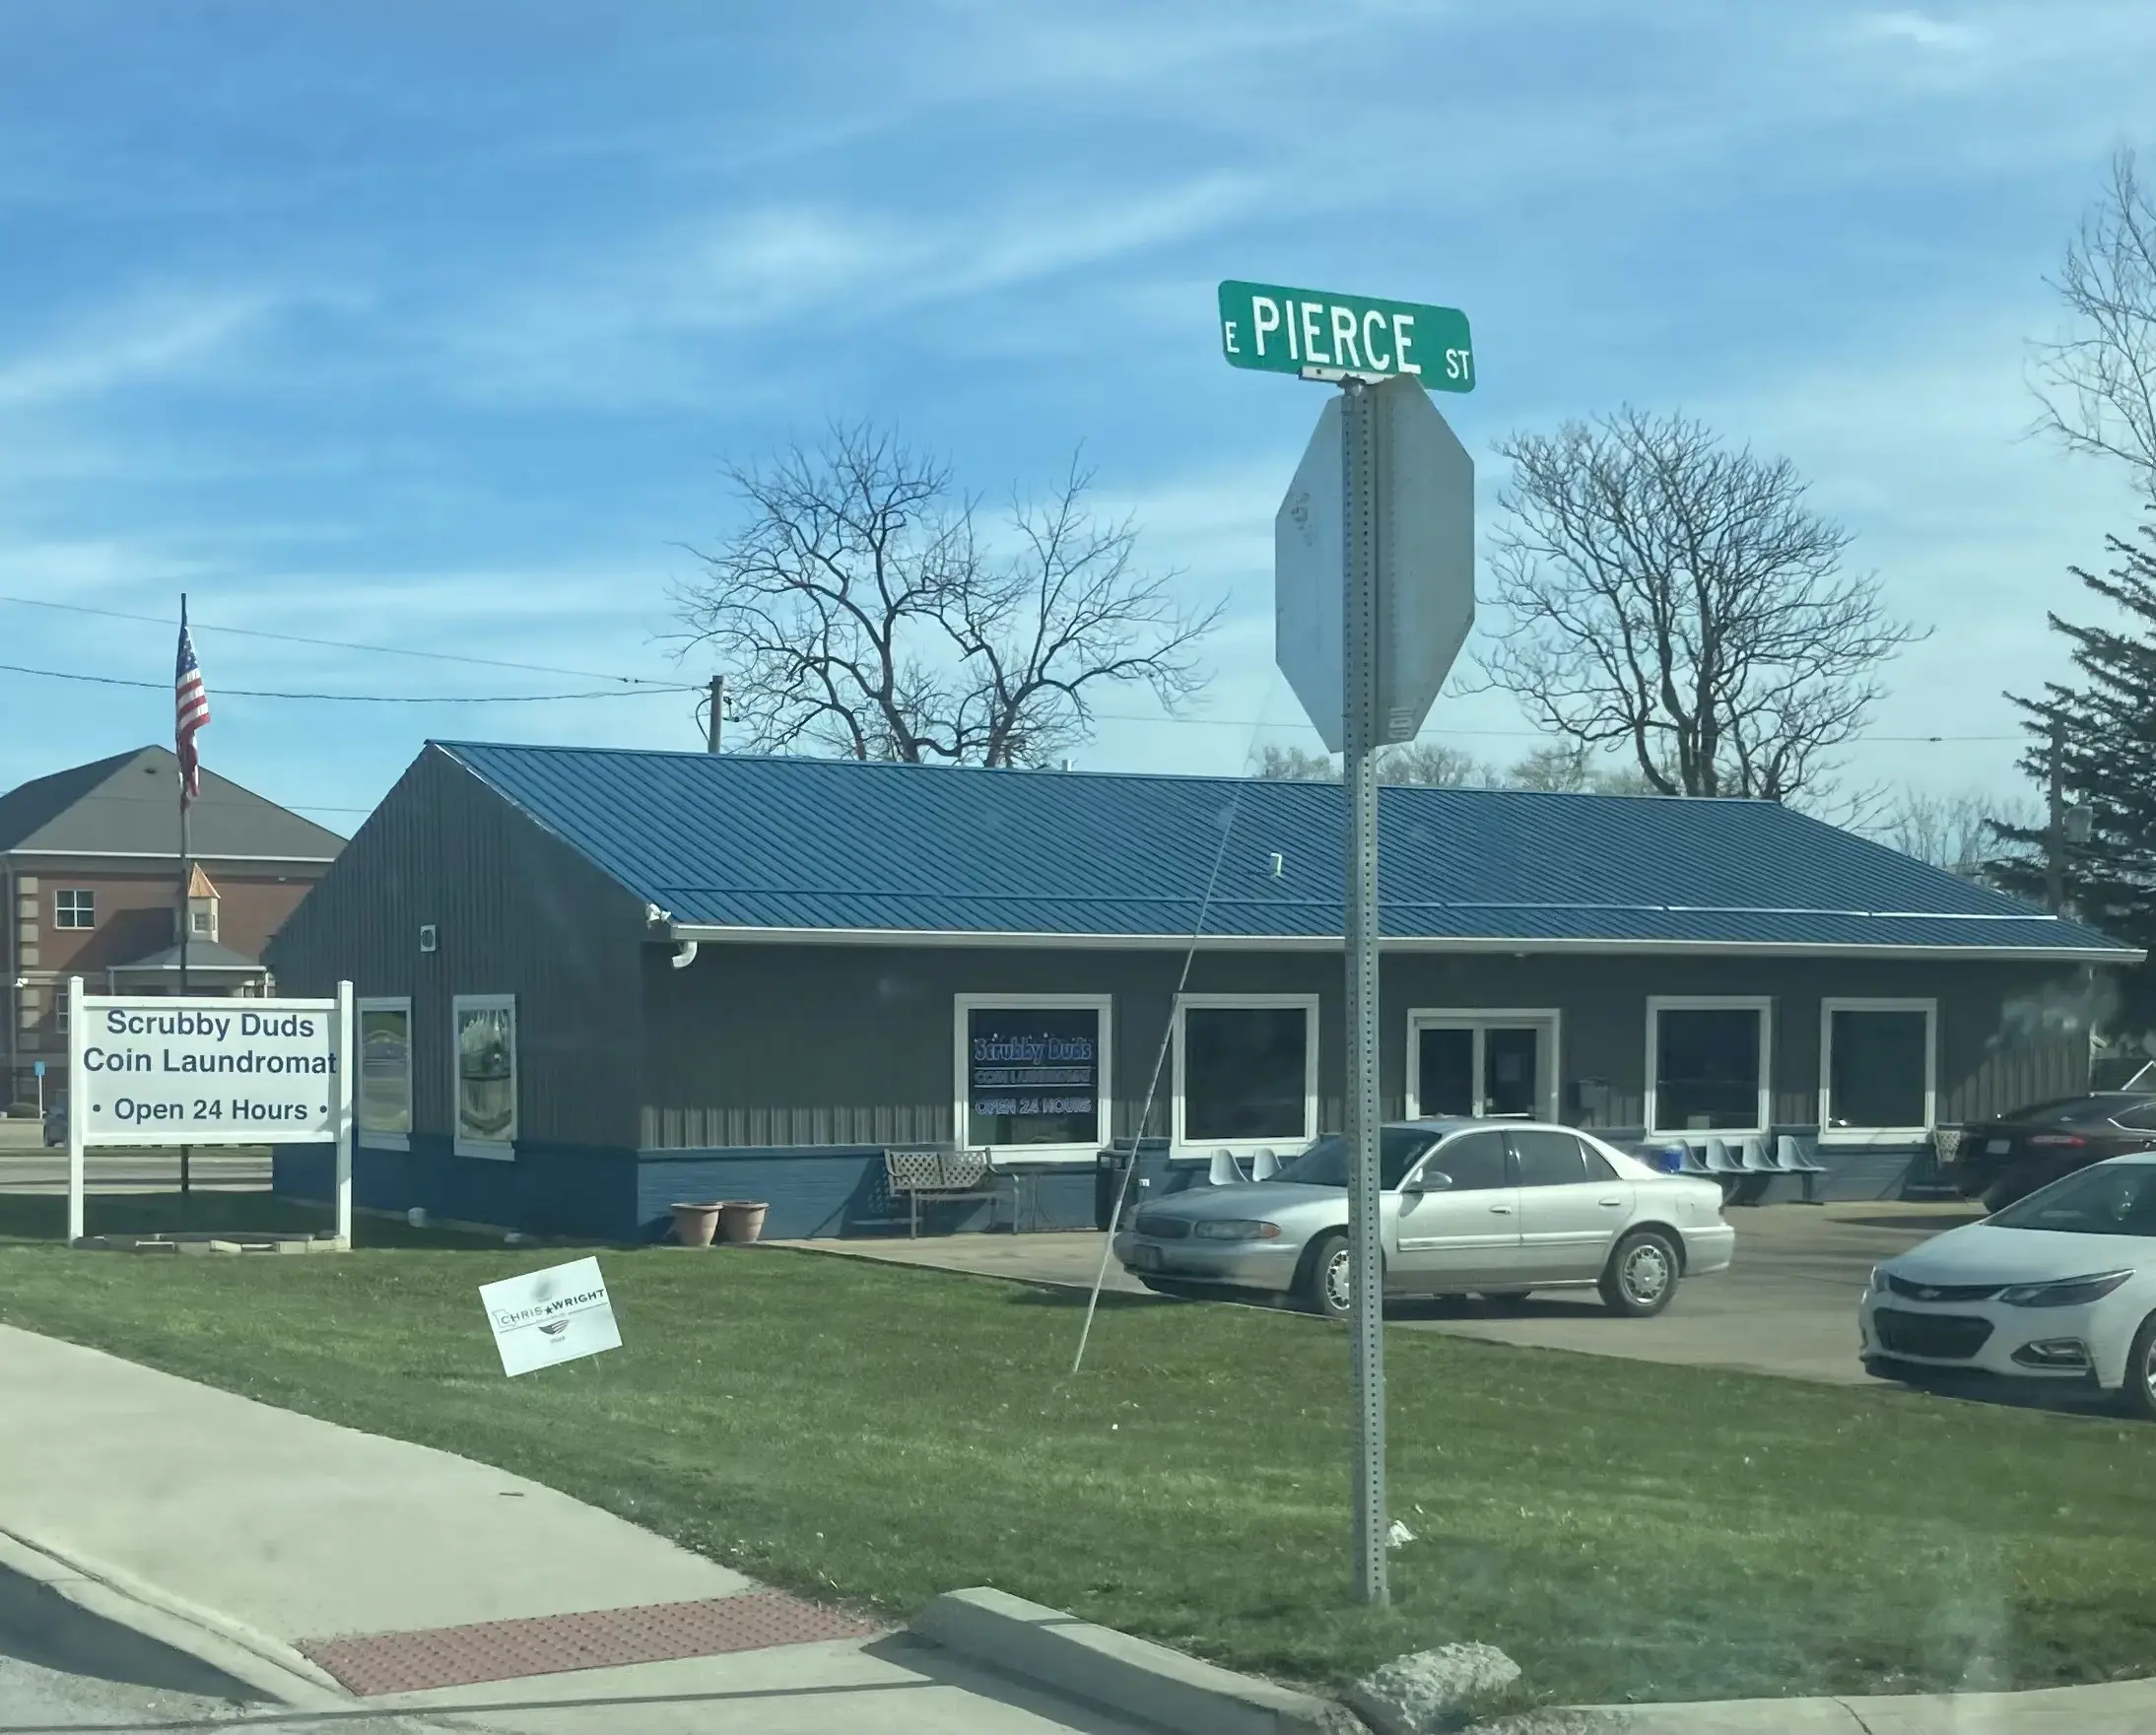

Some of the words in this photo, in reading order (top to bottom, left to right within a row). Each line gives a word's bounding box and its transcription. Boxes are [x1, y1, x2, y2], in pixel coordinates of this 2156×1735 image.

[1225, 321, 1240, 354] E
[1251, 296, 1421, 374] PIERCE
[1446, 348, 1470, 380] ST
[106, 1010, 231, 1041] Scrubby
[241, 1013, 315, 1037] Duds
[83, 1047, 152, 1072] Coin
[164, 1049, 337, 1074] Laundromat
[974, 1036, 1045, 1065] Scrubby
[1047, 1036, 1092, 1060] Duds
[114, 1098, 184, 1124] Open
[193, 1100, 223, 1119] 24
[233, 1100, 308, 1120] Hours
[975, 1099, 1016, 1115] OPEN
[1019, 1098, 1039, 1114] 24
[1043, 1097, 1092, 1114] HOURS
[501, 1305, 543, 1325] CHRIS
[552, 1289, 605, 1311] WRIGHT
